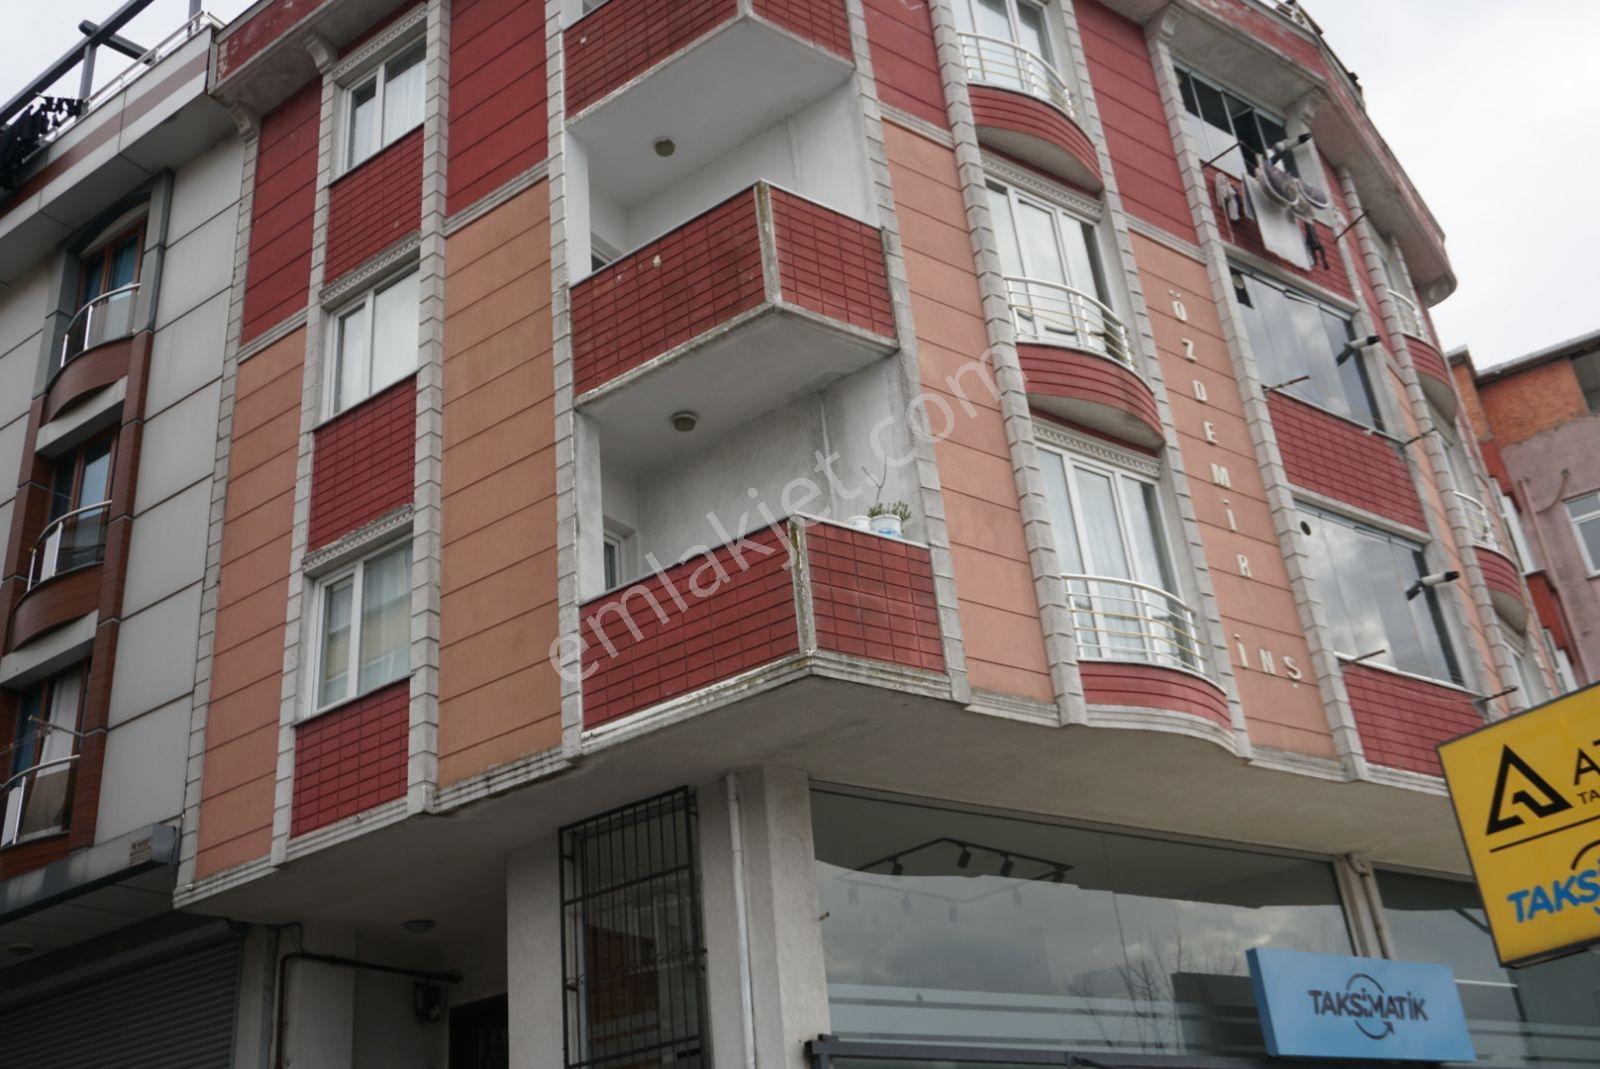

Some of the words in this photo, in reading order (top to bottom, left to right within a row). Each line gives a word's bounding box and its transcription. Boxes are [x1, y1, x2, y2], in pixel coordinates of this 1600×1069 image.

[1233, 633, 1302, 689] İNŞ
[1574, 738, 1600, 786] A
[1507, 857, 1600, 923] TAKS
